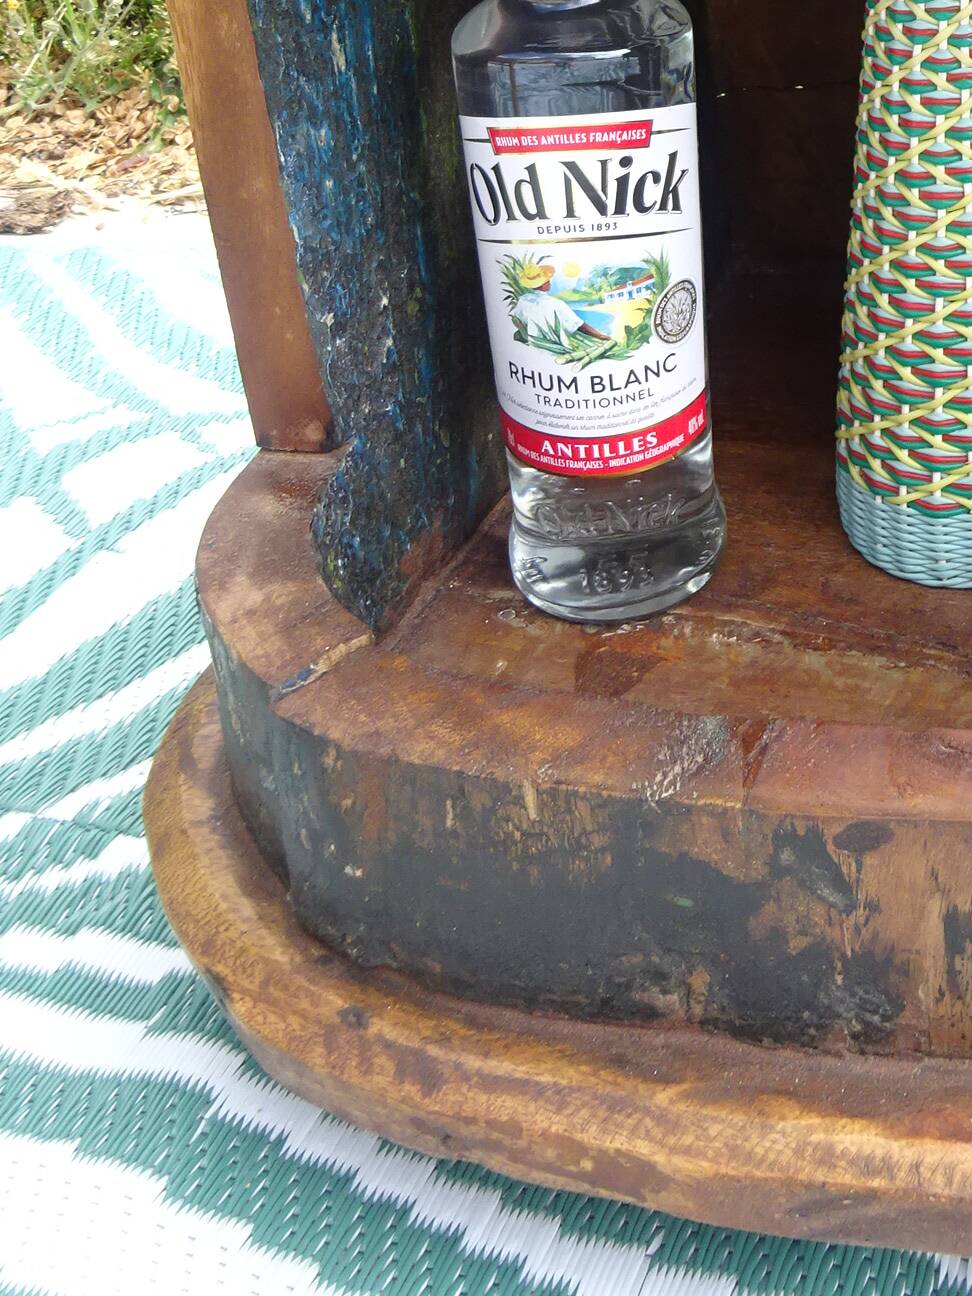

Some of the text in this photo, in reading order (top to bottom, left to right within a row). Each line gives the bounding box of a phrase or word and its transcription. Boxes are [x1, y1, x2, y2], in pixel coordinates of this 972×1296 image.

[495, 129, 646, 147] RHUM DES ANTILLES FRANÇAISES
[470, 150, 689, 226] Old Nick
[537, 222, 618, 235] DEPUIS 1893
[509, 353, 677, 394] RHUM BLANC
[535, 388, 654, 409] TRADITIONNEL
[540, 454, 566, 467] ANTILLES
[566, 460, 604, 471] FRANÇAISES
[609, 453, 644, 467] INDICATION
[644, 434, 685, 459] GÉOGRAPHIQUE
[541, 431, 658, 458] ANTILLES
